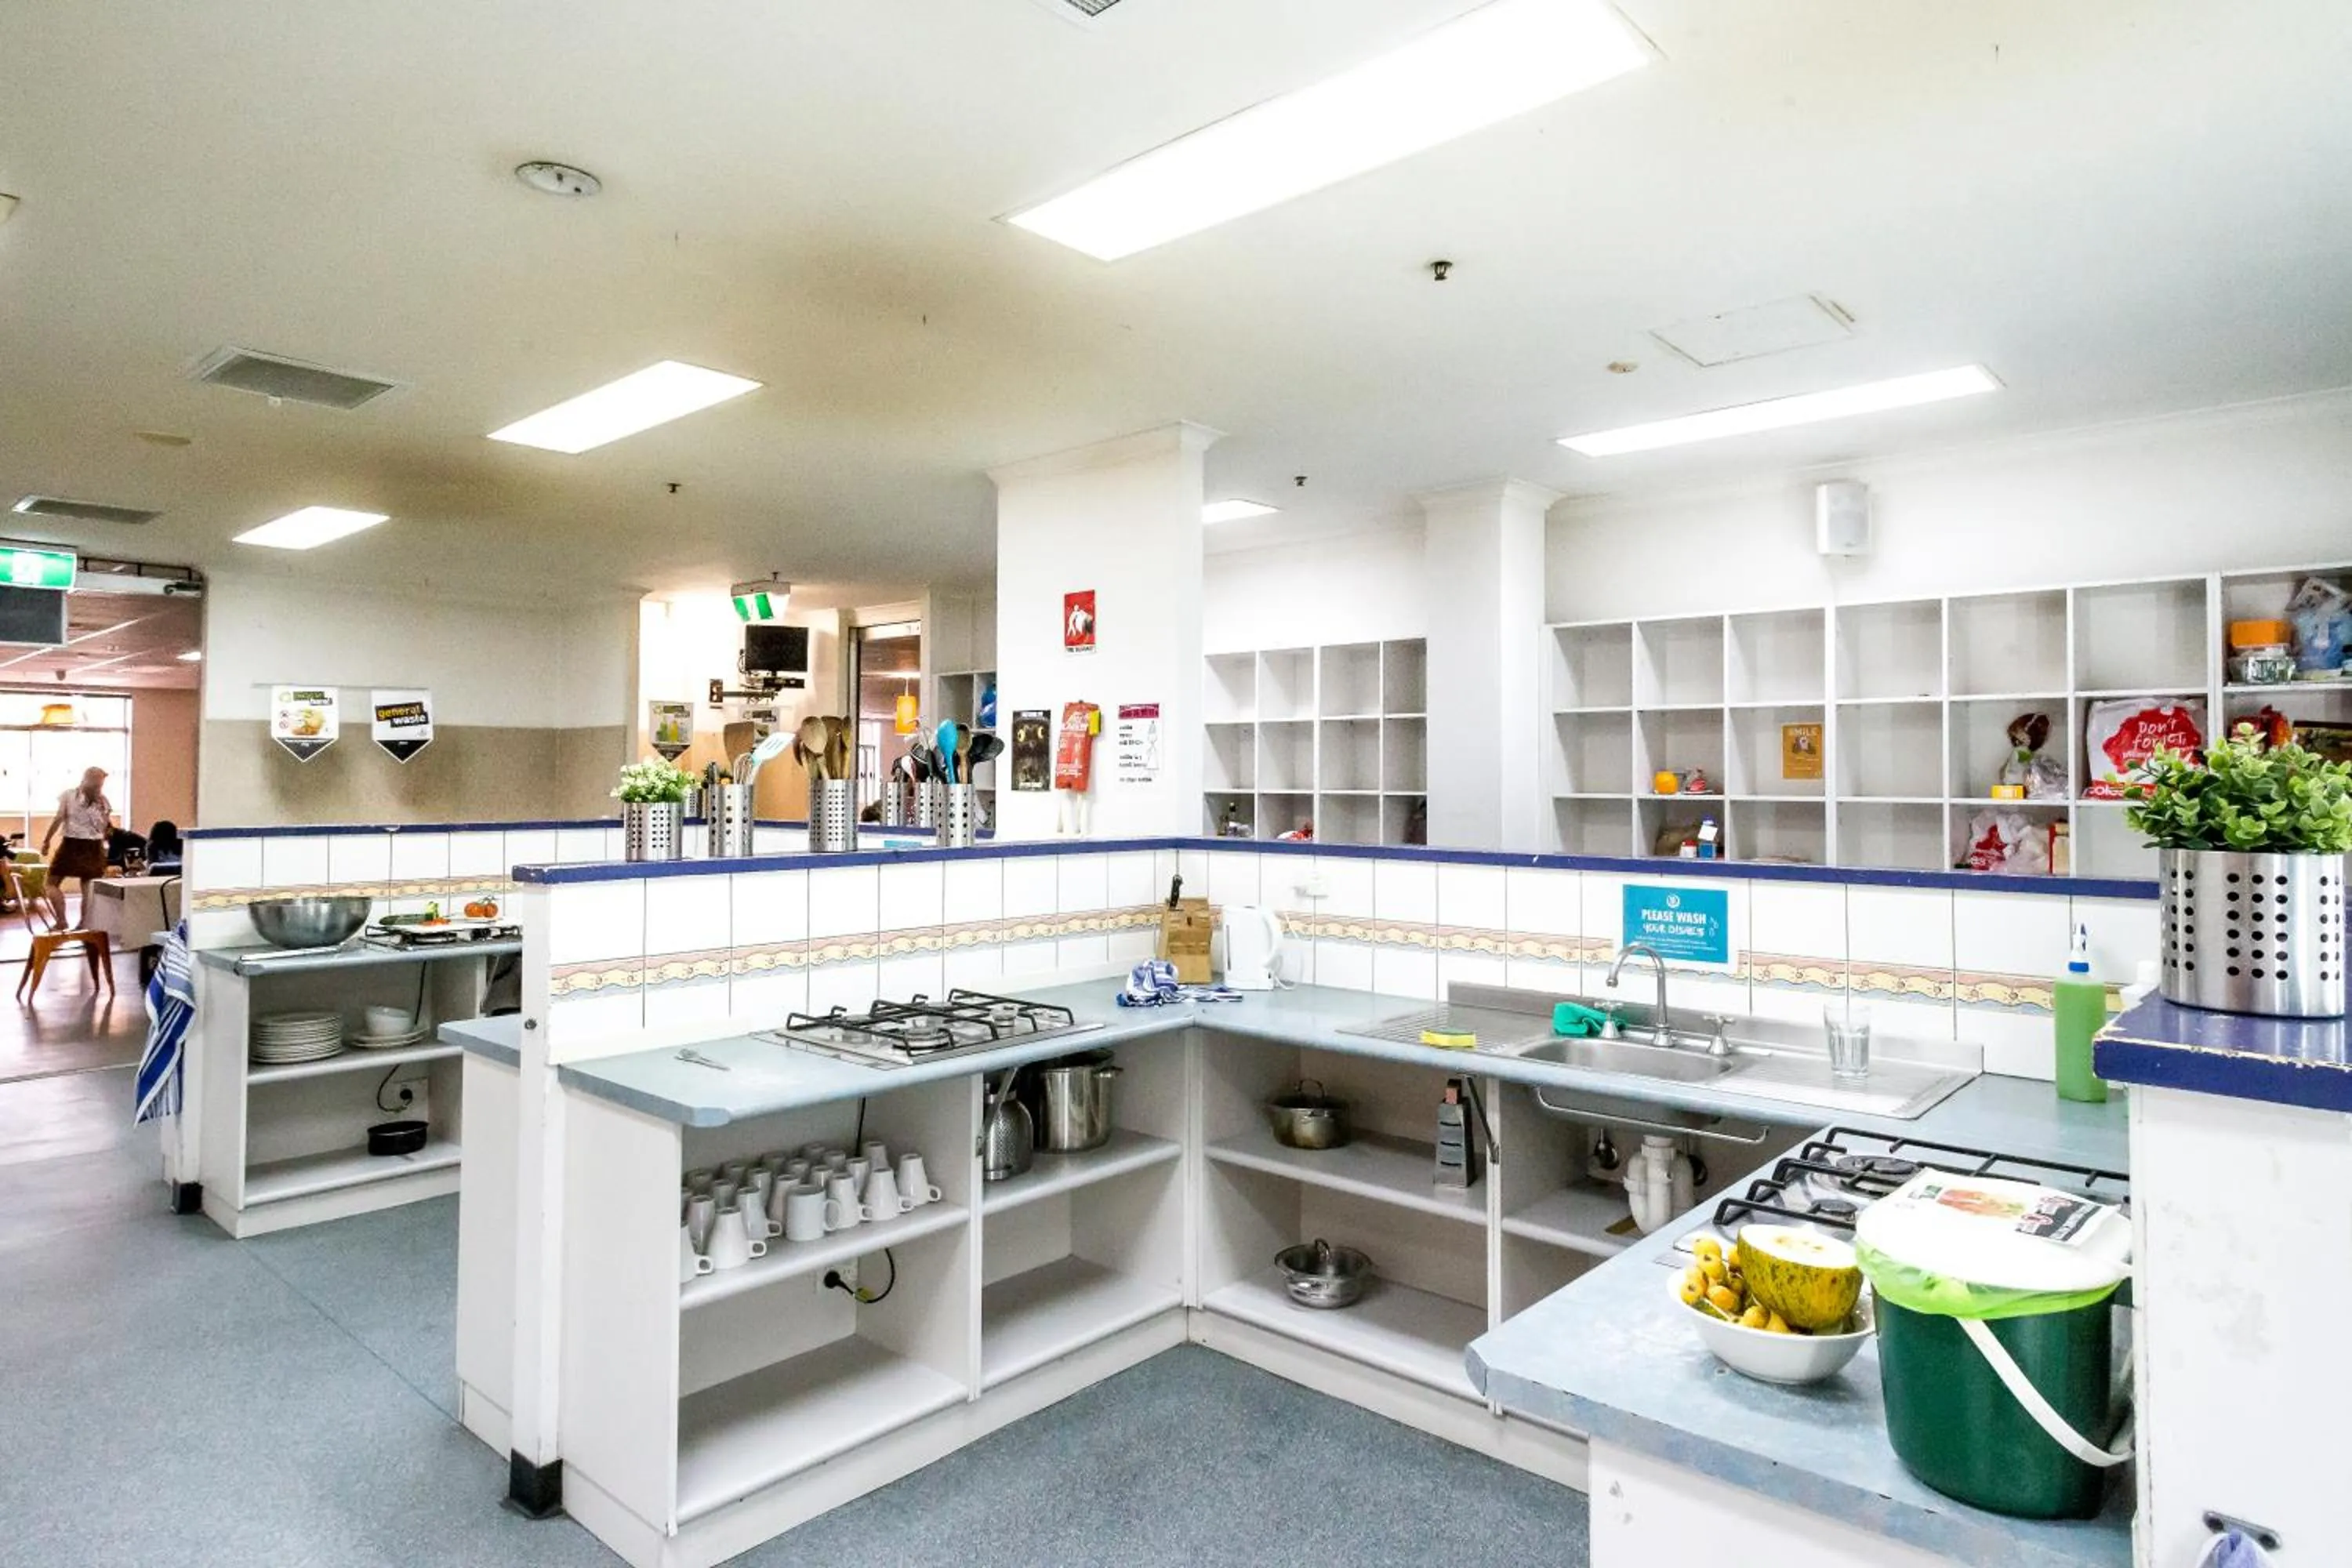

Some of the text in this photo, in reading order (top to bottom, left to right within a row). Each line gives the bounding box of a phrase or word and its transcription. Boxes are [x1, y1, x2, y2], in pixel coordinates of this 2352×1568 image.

[377, 706, 421, 720] general
[392, 714, 426, 725] waste
[1641, 909, 1707, 924] PLEASE WASH
[1642, 922, 1705, 937] YOUR DISHES
